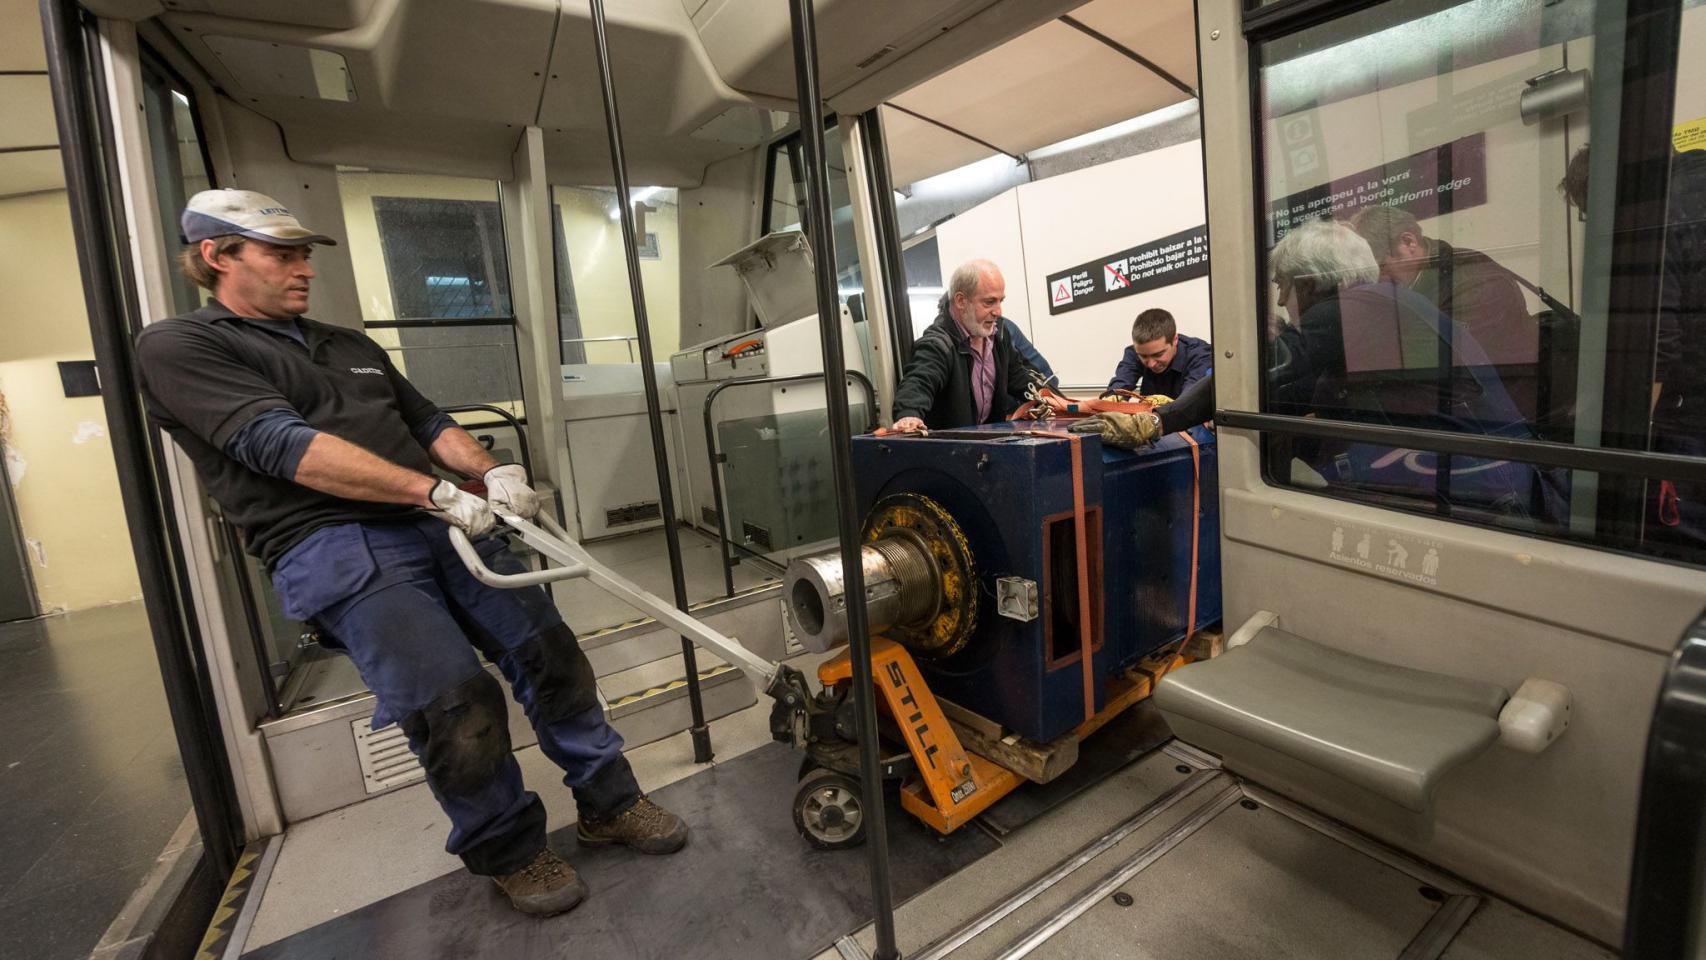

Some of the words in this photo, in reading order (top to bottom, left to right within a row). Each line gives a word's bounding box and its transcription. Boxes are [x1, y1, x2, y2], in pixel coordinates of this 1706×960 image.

[1276, 209, 1289, 218] No
[1292, 204, 1304, 214] us
[1307, 189, 1353, 210] apropeu
[1357, 186, 1364, 194] a
[1367, 180, 1378, 191] la
[1382, 171, 1410, 186] vora
[1381, 186, 1433, 208] platform
[1437, 176, 1471, 193] edge
[1276, 219, 1290, 229] No
[1293, 202, 1344, 223] acercarse
[1347, 196, 1357, 208] al
[1360, 187, 1395, 204] borde
[1129, 249, 1158, 264] Prohibit
[1159, 242, 1185, 254] baixar
[1186, 239, 1192, 247] a
[1194, 236, 1202, 245] la
[1130, 257, 1164, 273] Prohibido
[1165, 251, 1185, 264] bajar
[1194, 245, 1202, 254] la
[1072, 271, 1088, 281] Perill
[1131, 273, 1141, 281] Do
[1142, 269, 1155, 278] not
[1156, 263, 1173, 275] walk
[1175, 261, 1185, 269] on
[1186, 256, 1200, 266] the
[1073, 278, 1093, 289] Peligro
[1073, 286, 1095, 297] Danger
[1330, 551, 1372, 569] Asientos
[1375, 563, 1437, 585] reservados
[886, 661, 938, 770] STILL
